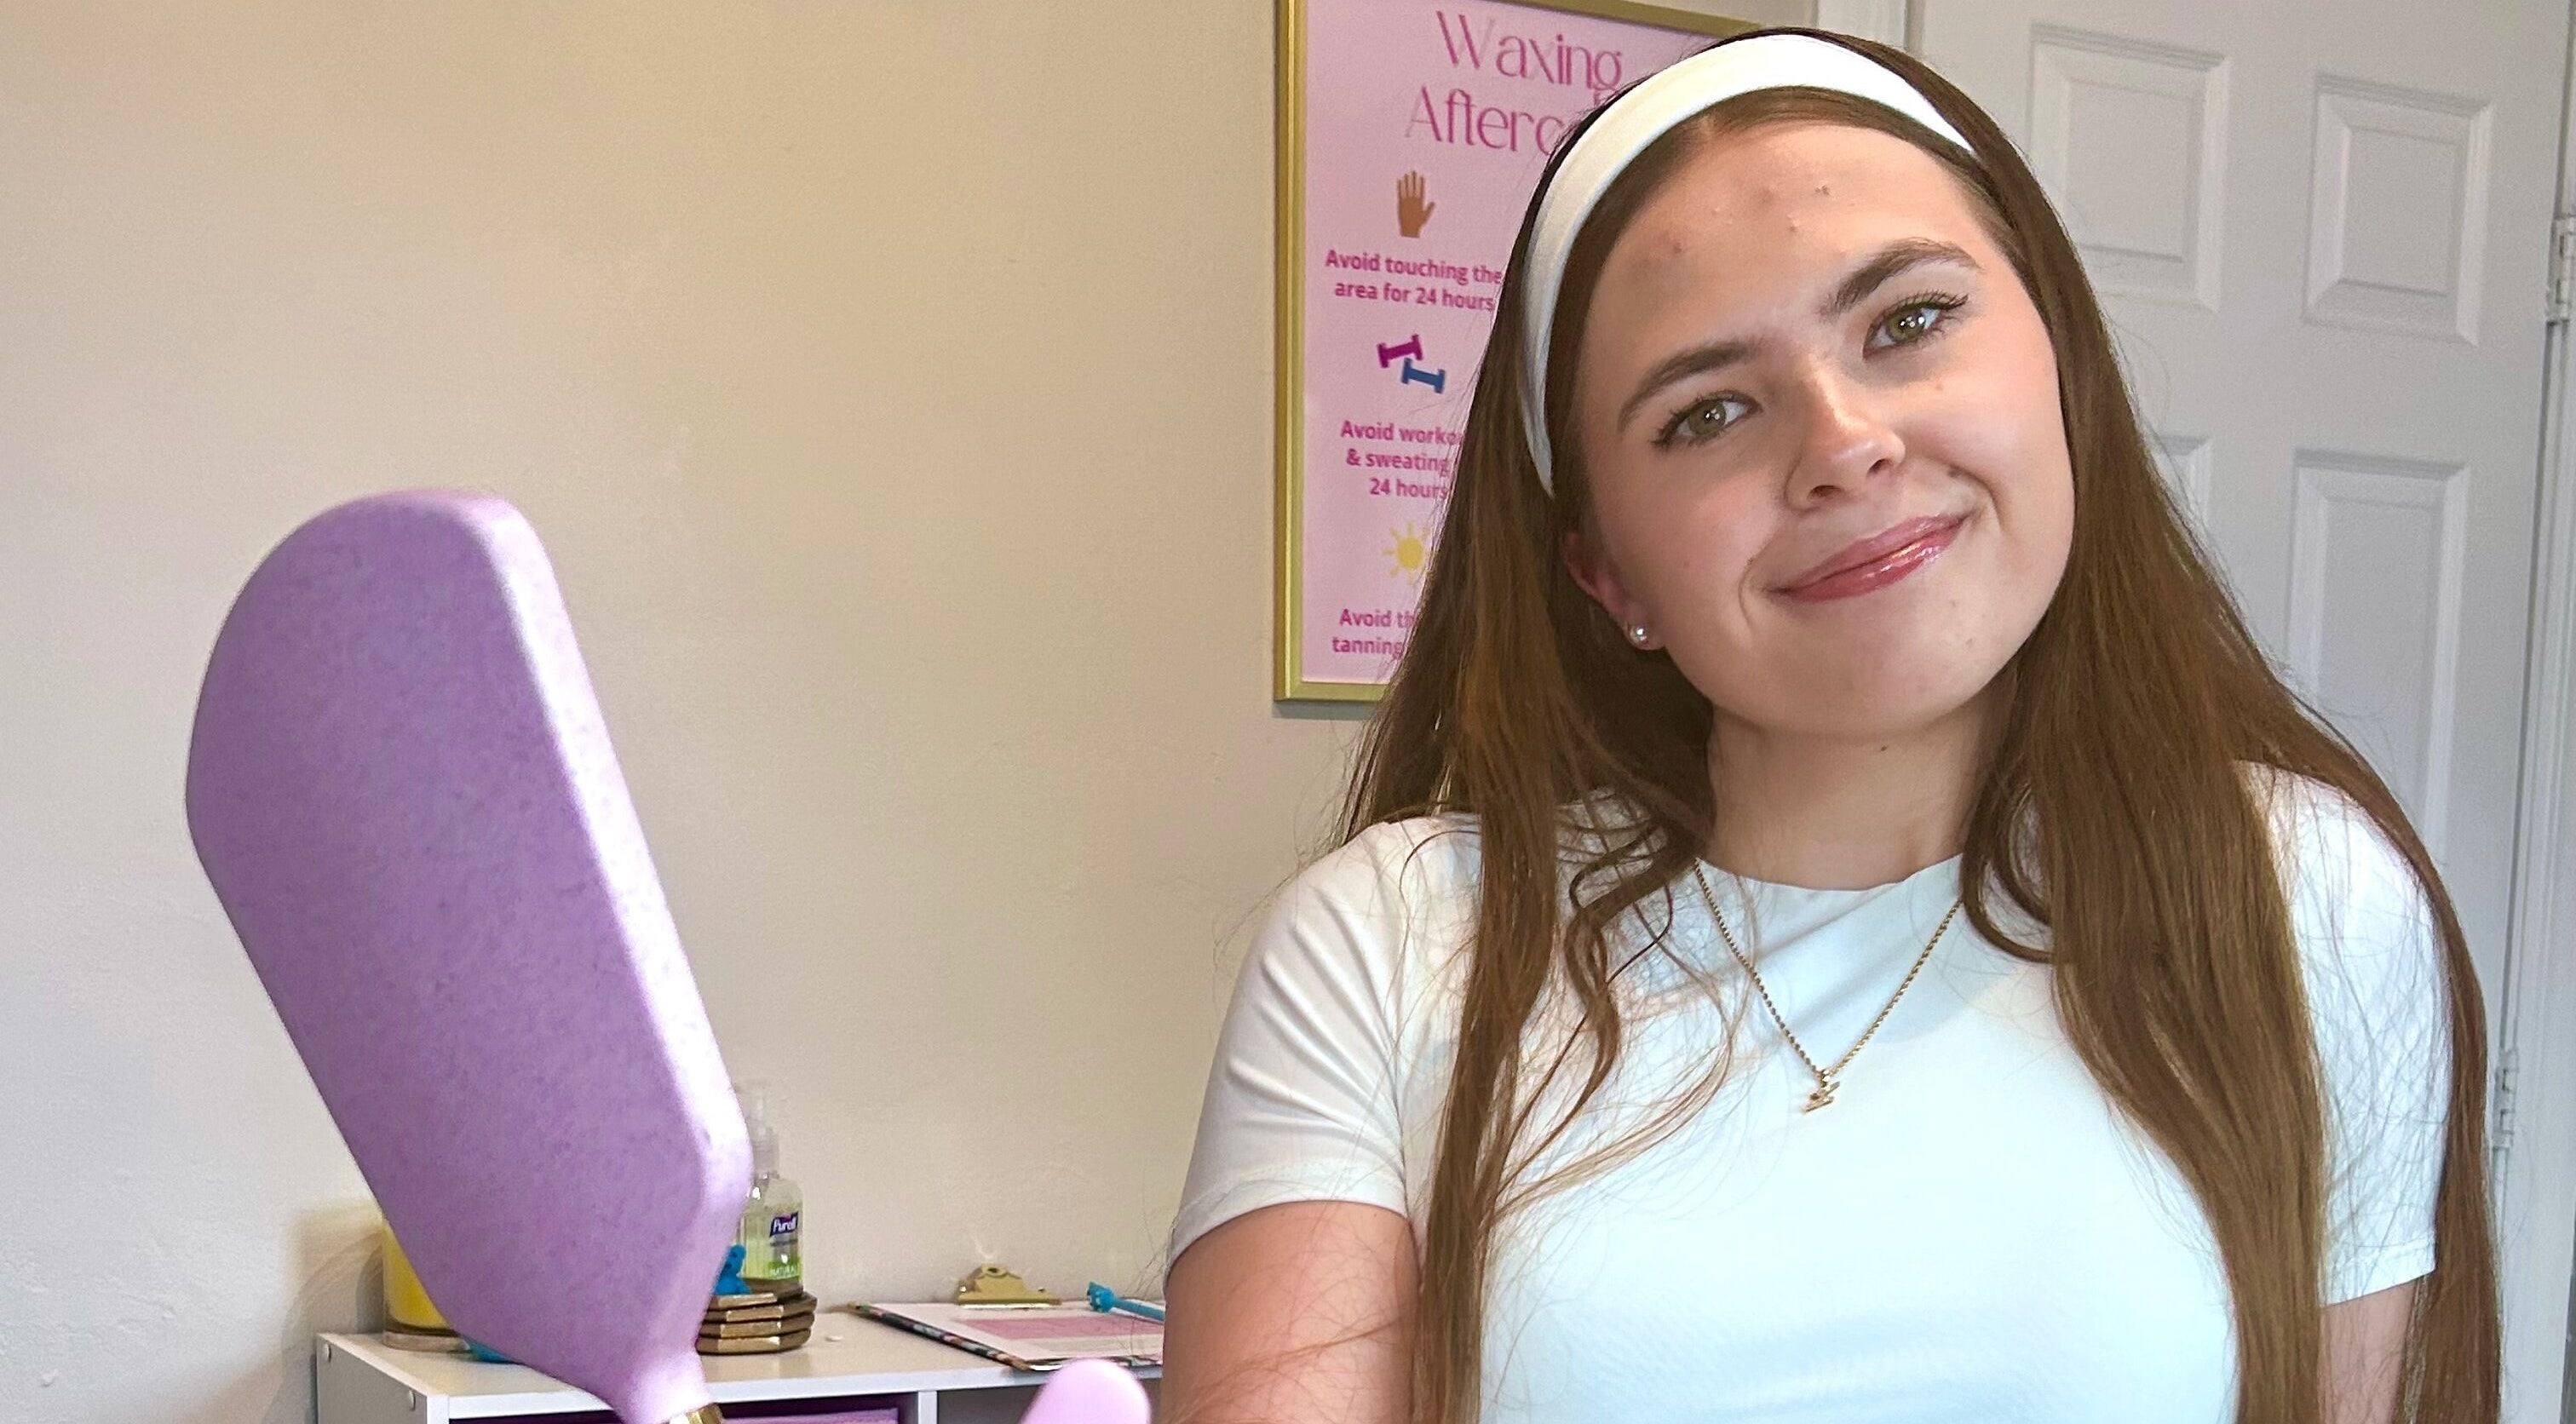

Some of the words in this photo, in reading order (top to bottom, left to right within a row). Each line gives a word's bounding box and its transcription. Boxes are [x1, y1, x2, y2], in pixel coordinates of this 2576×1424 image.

[1436, 10, 1623, 106] Waxing
[1405, 85, 1566, 156] Afterc
[1325, 250, 1380, 272] Avoid
[1385, 258, 1468, 285] touching
[1472, 265, 1502, 284] the
[1335, 282, 1377, 300] area
[1383, 283, 1411, 302] for
[1417, 287, 1437, 304] 24
[1442, 289, 1496, 312] hours
[1341, 420, 1394, 440] Avoid
[1399, 427, 1459, 445] worko
[1346, 448, 1360, 466] &
[1366, 452, 1449, 478] sweating
[1370, 477, 1390, 495] 24
[1396, 479, 1447, 500] hours
[1340, 608, 1392, 627] Avoid
[1397, 611, 1414, 628] th
[1332, 637, 1404, 660] tanning
